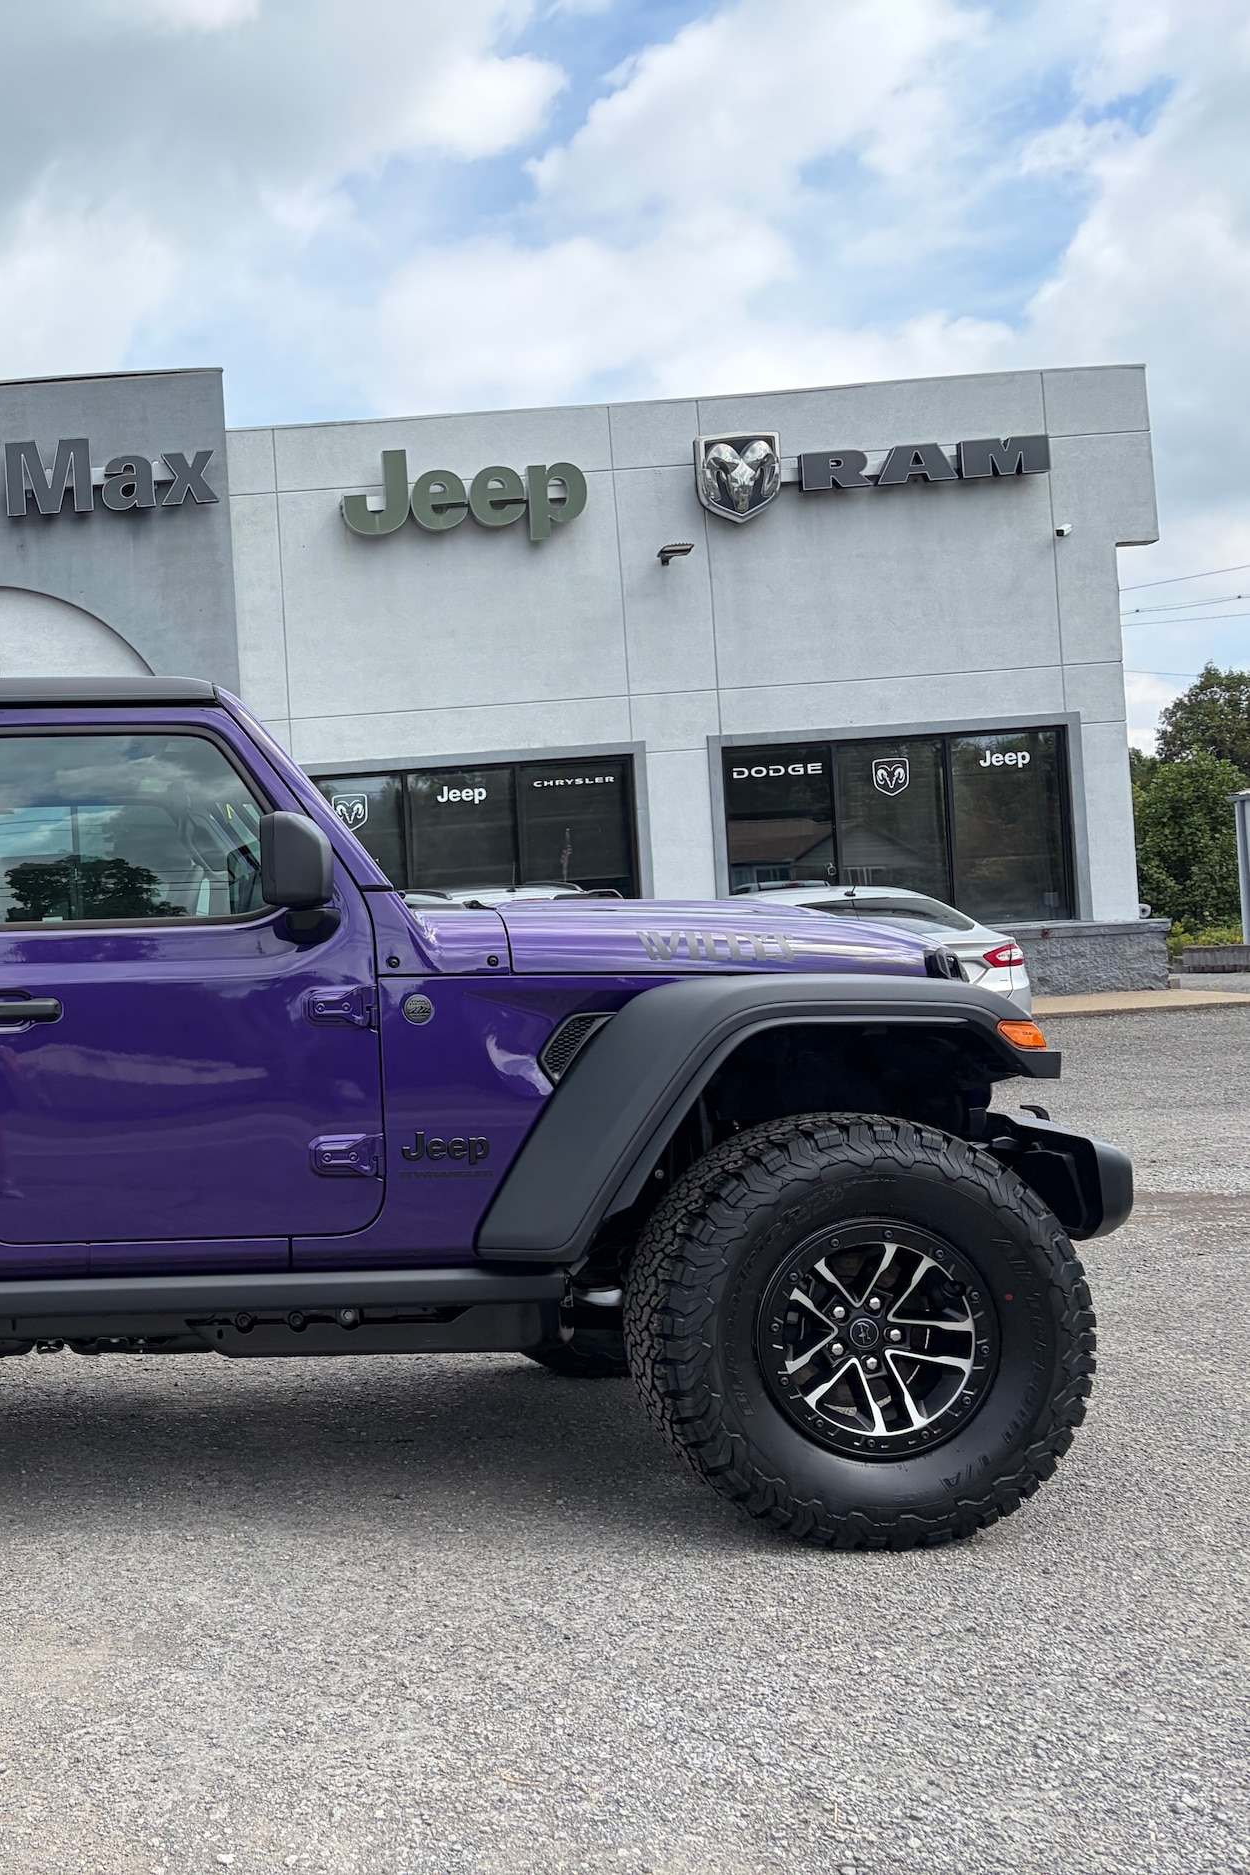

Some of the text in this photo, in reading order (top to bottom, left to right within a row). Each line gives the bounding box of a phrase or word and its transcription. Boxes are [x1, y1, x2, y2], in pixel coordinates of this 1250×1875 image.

[4, 437, 220, 518] Max
[799, 434, 1050, 493] RAM
[341, 449, 587, 541] Jeep
[733, 763, 822, 779] DODGE
[979, 750, 1030, 769] Jeep
[437, 786, 487, 804] Jeep
[533, 776, 616, 788] CHRYSLER
[635, 931, 796, 963] WILLYS
[401, 1131, 490, 1166] Jeep
